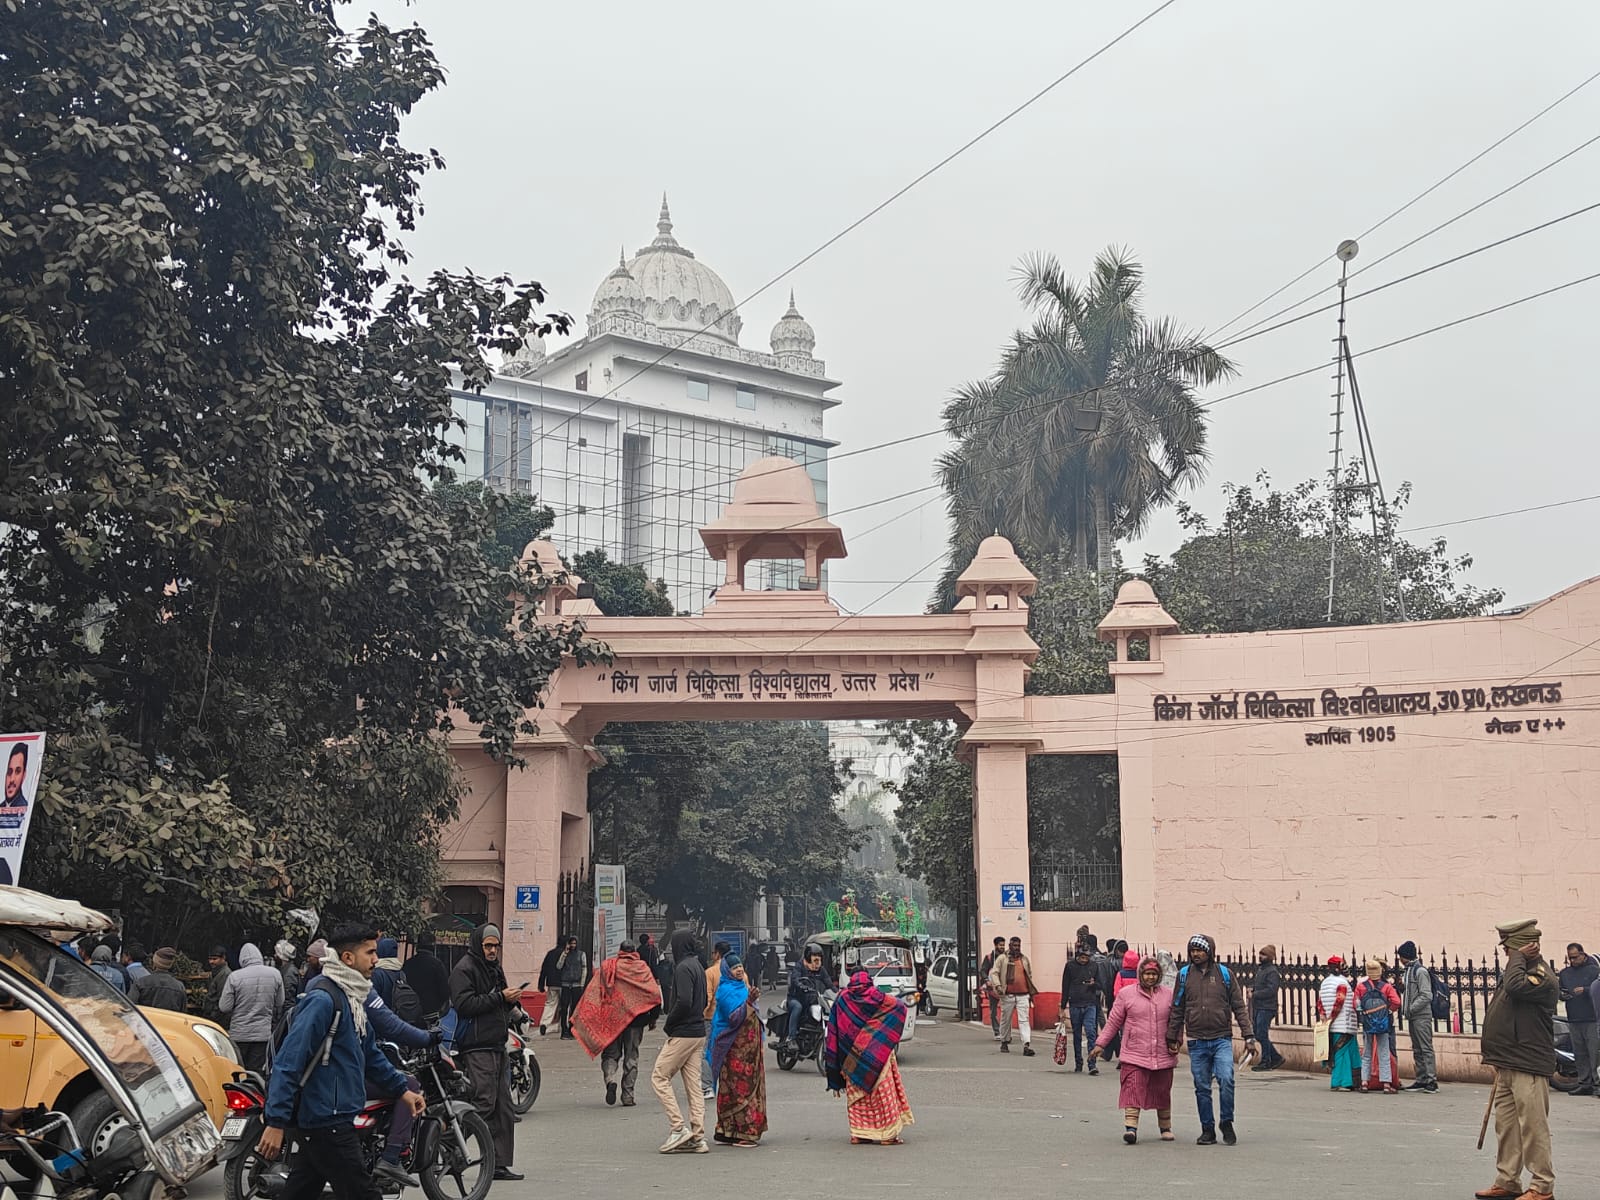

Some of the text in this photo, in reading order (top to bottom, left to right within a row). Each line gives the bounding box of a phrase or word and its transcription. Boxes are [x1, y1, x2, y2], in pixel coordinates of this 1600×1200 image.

[648, 668, 678, 693] जार्ज
[686, 669, 740, 693] चिकित्सा
[841, 672, 877, 692] उत्तर
[1153, 694, 1192, 721] किंग
[1197, 691, 1240, 720] जॉर्ज
[1244, 690, 1315, 719] चिकित्सा
[1305, 725, 1396, 746] स्थापित 1905
[523, 892, 532, 904] 2
[1008, 890, 1017, 901] 2
